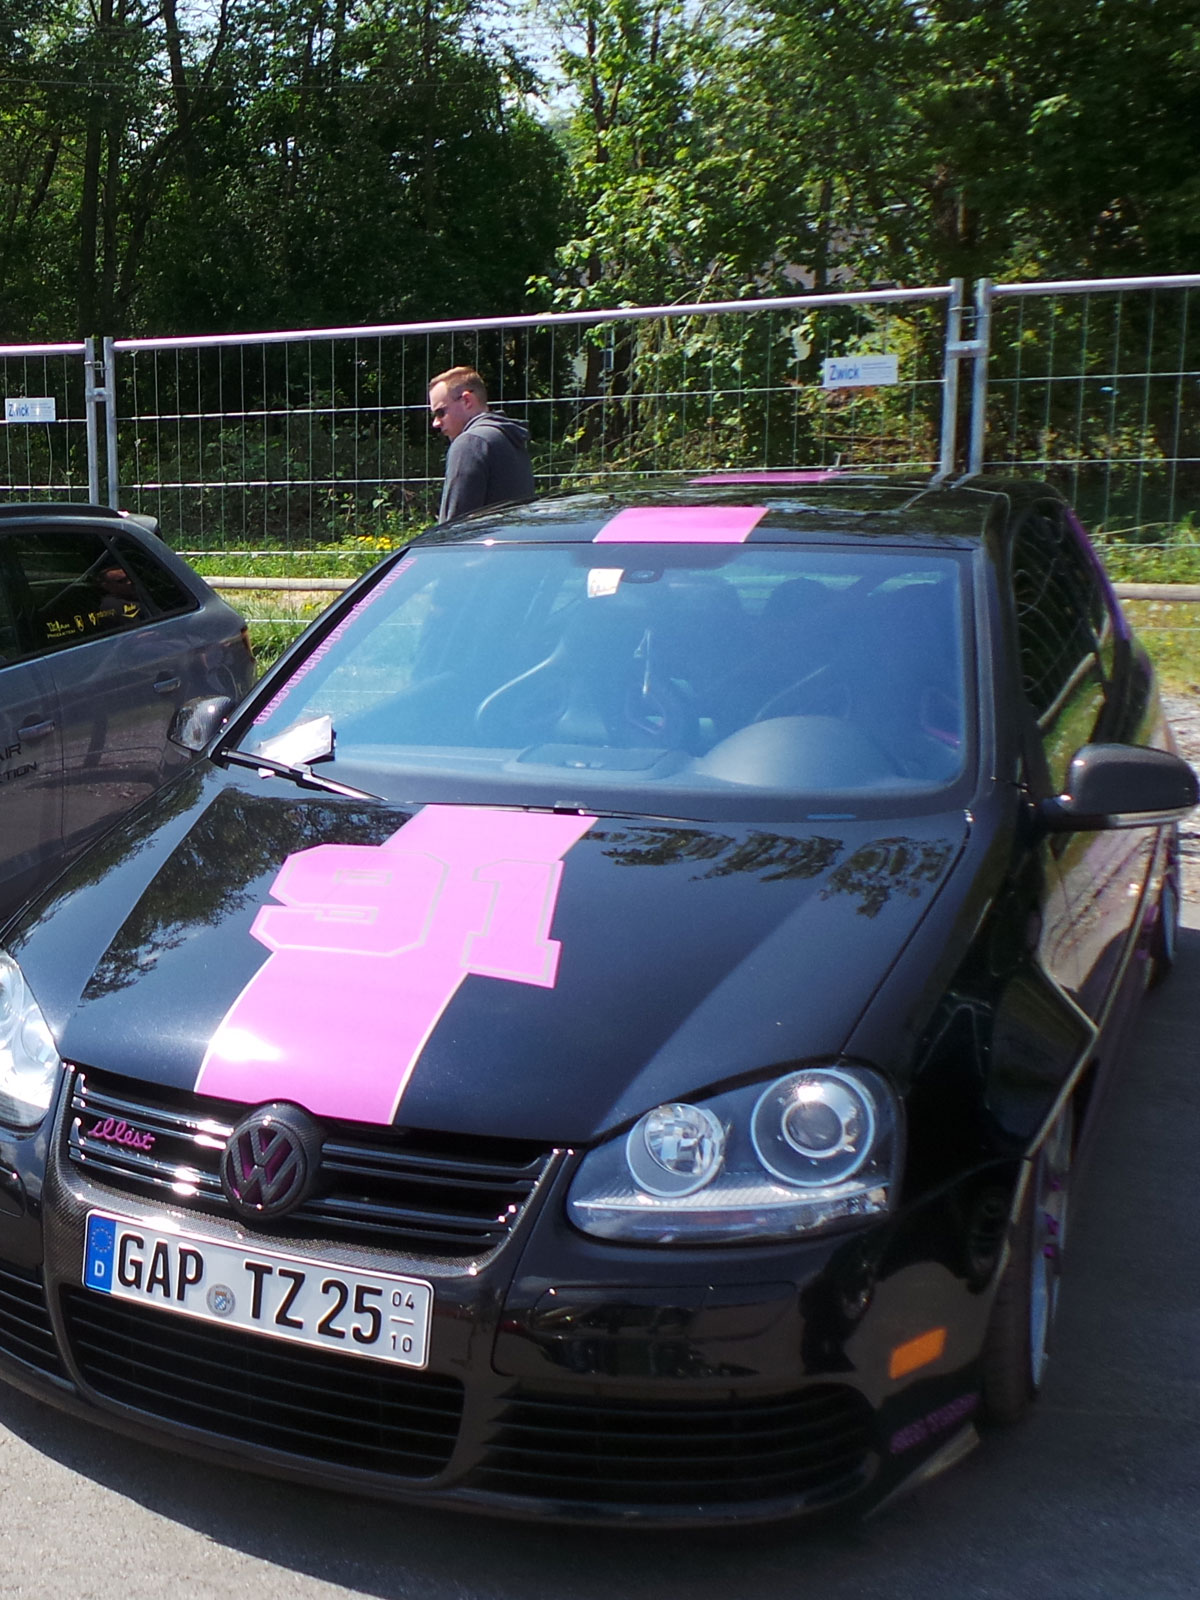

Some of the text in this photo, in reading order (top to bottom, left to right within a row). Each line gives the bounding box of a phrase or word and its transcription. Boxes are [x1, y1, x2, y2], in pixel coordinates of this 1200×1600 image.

[829, 364, 860, 380] Zwick
[249, 843, 565, 989] 91
[88, 1118, 155, 1150] illest
[94, 1261, 105, 1277] D
[117, 1233, 383, 1344] GAP TZ 25
[391, 1290, 415, 1310] 04
[390, 1334, 413, 1353] 10
